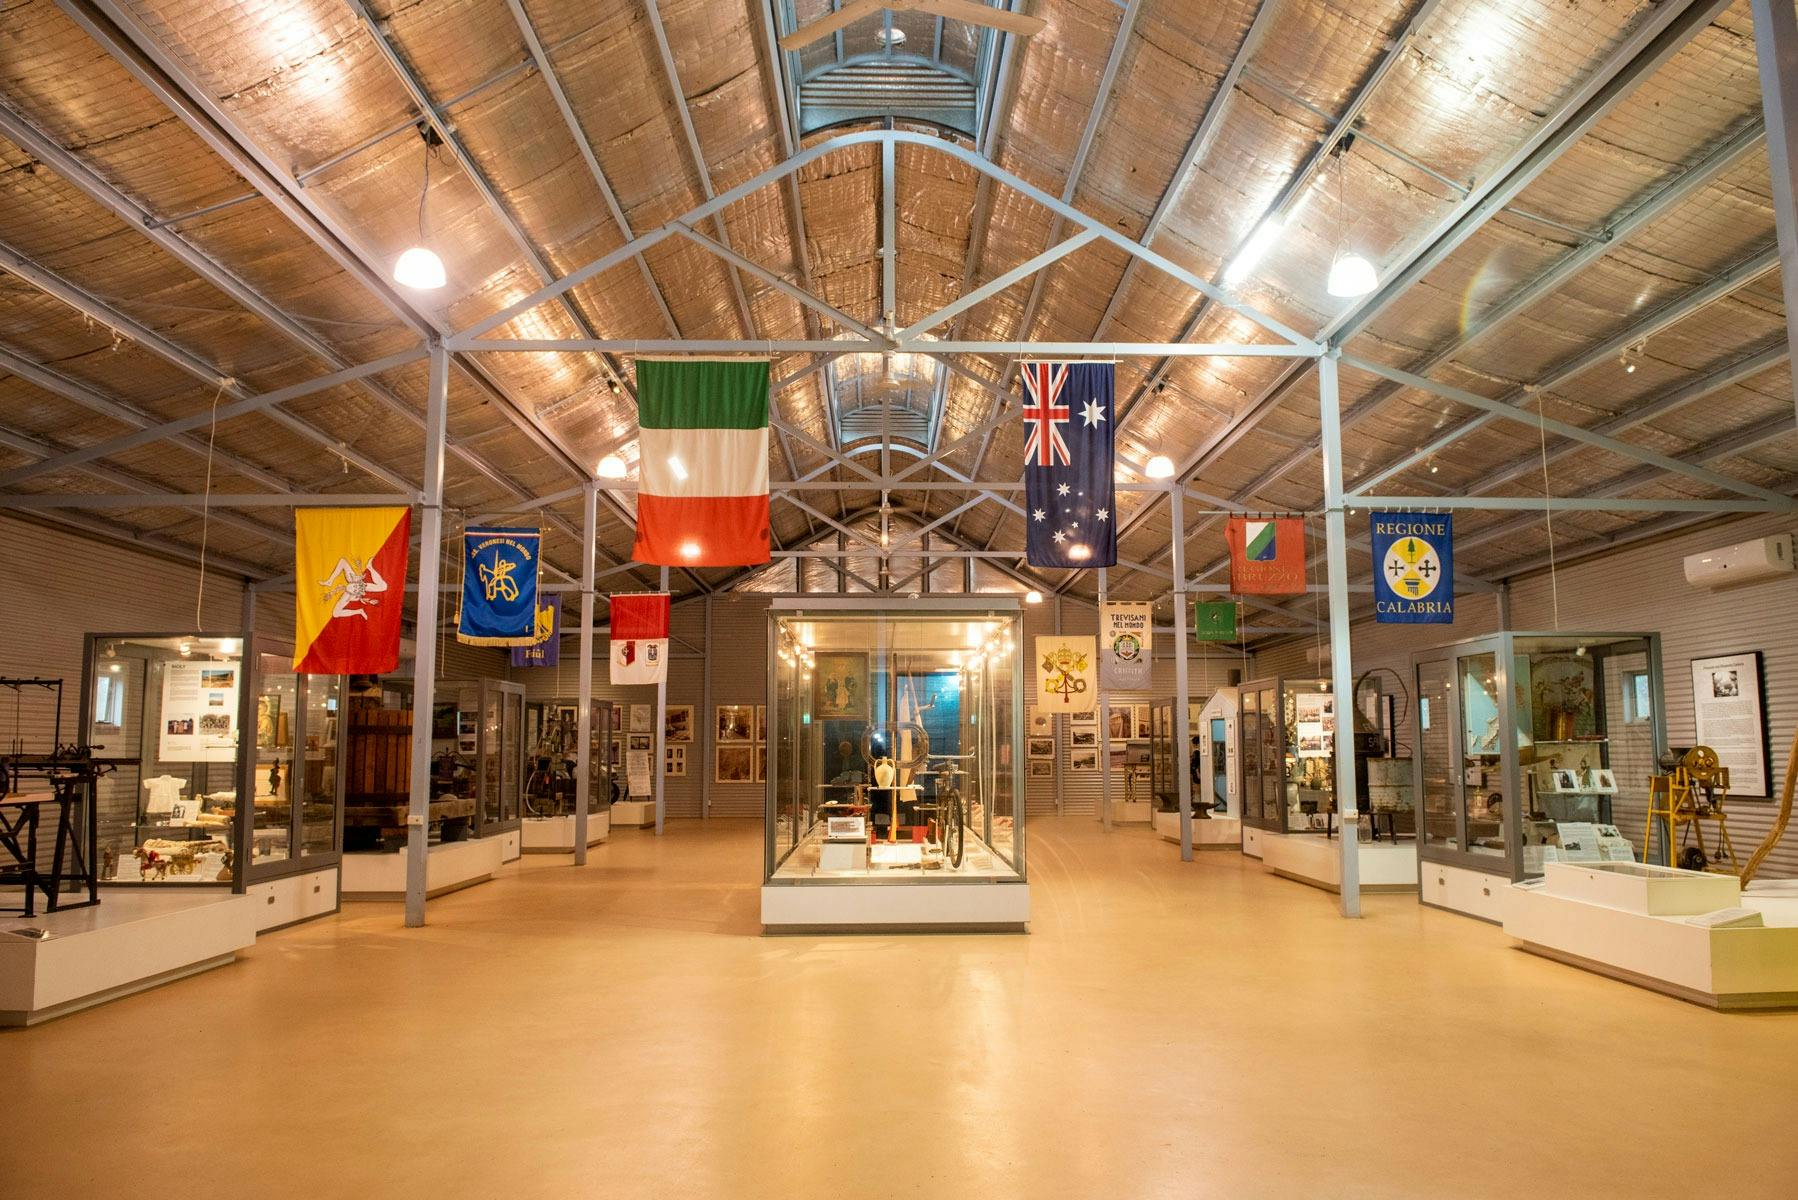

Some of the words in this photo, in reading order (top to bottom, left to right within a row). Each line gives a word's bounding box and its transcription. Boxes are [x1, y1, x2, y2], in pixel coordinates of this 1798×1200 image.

[1375, 522, 1446, 536] REGIONE
[478, 538, 505, 549] VERONESI
[505, 538, 516, 547] NEL
[516, 543, 532, 560] MONDO
[1376, 601, 1452, 613] CALABRIA
[1110, 613, 1147, 622] TREVISANI
[1113, 621, 1124, 629] NEL
[1124, 621, 1144, 629] MONDO
